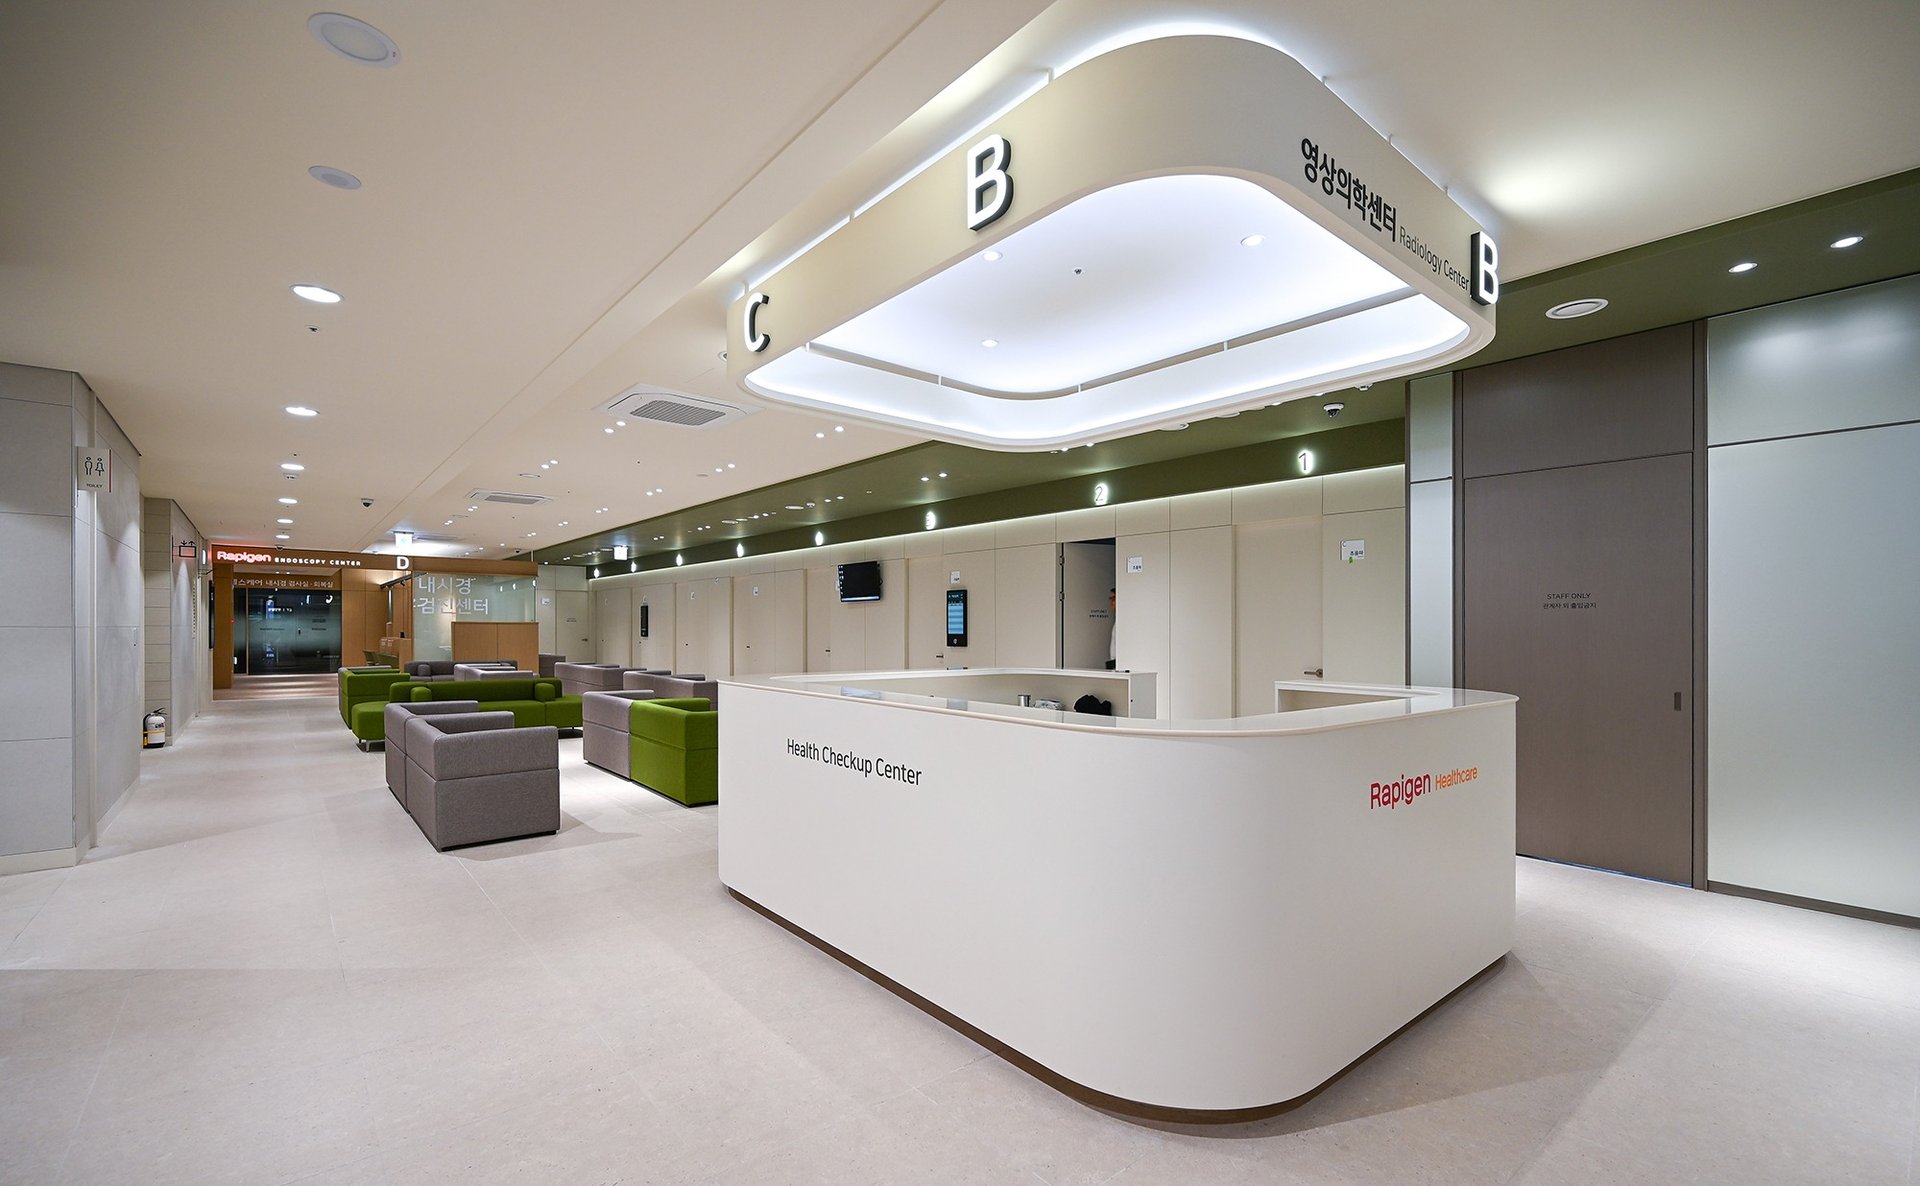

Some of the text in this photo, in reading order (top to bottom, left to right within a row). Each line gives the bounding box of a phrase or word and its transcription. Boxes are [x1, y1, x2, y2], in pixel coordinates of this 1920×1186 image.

[967, 134, 1014, 232] B
[1301, 137, 1500, 306] 영상의학센터 Radiology Center B
[743, 291, 771, 353] C
[216, 550, 361, 567] Rapigen ENDOSCOPY CENTER
[396, 556, 410, 570] D
[418, 576, 472, 595] 내시경
[1547, 592, 1591, 600] STAFF ONLY
[417, 597, 489, 615] 검진센터
[786, 737, 922, 786] Health Checkup Center
[1370, 766, 1478, 810] Rapigen Healthcare
